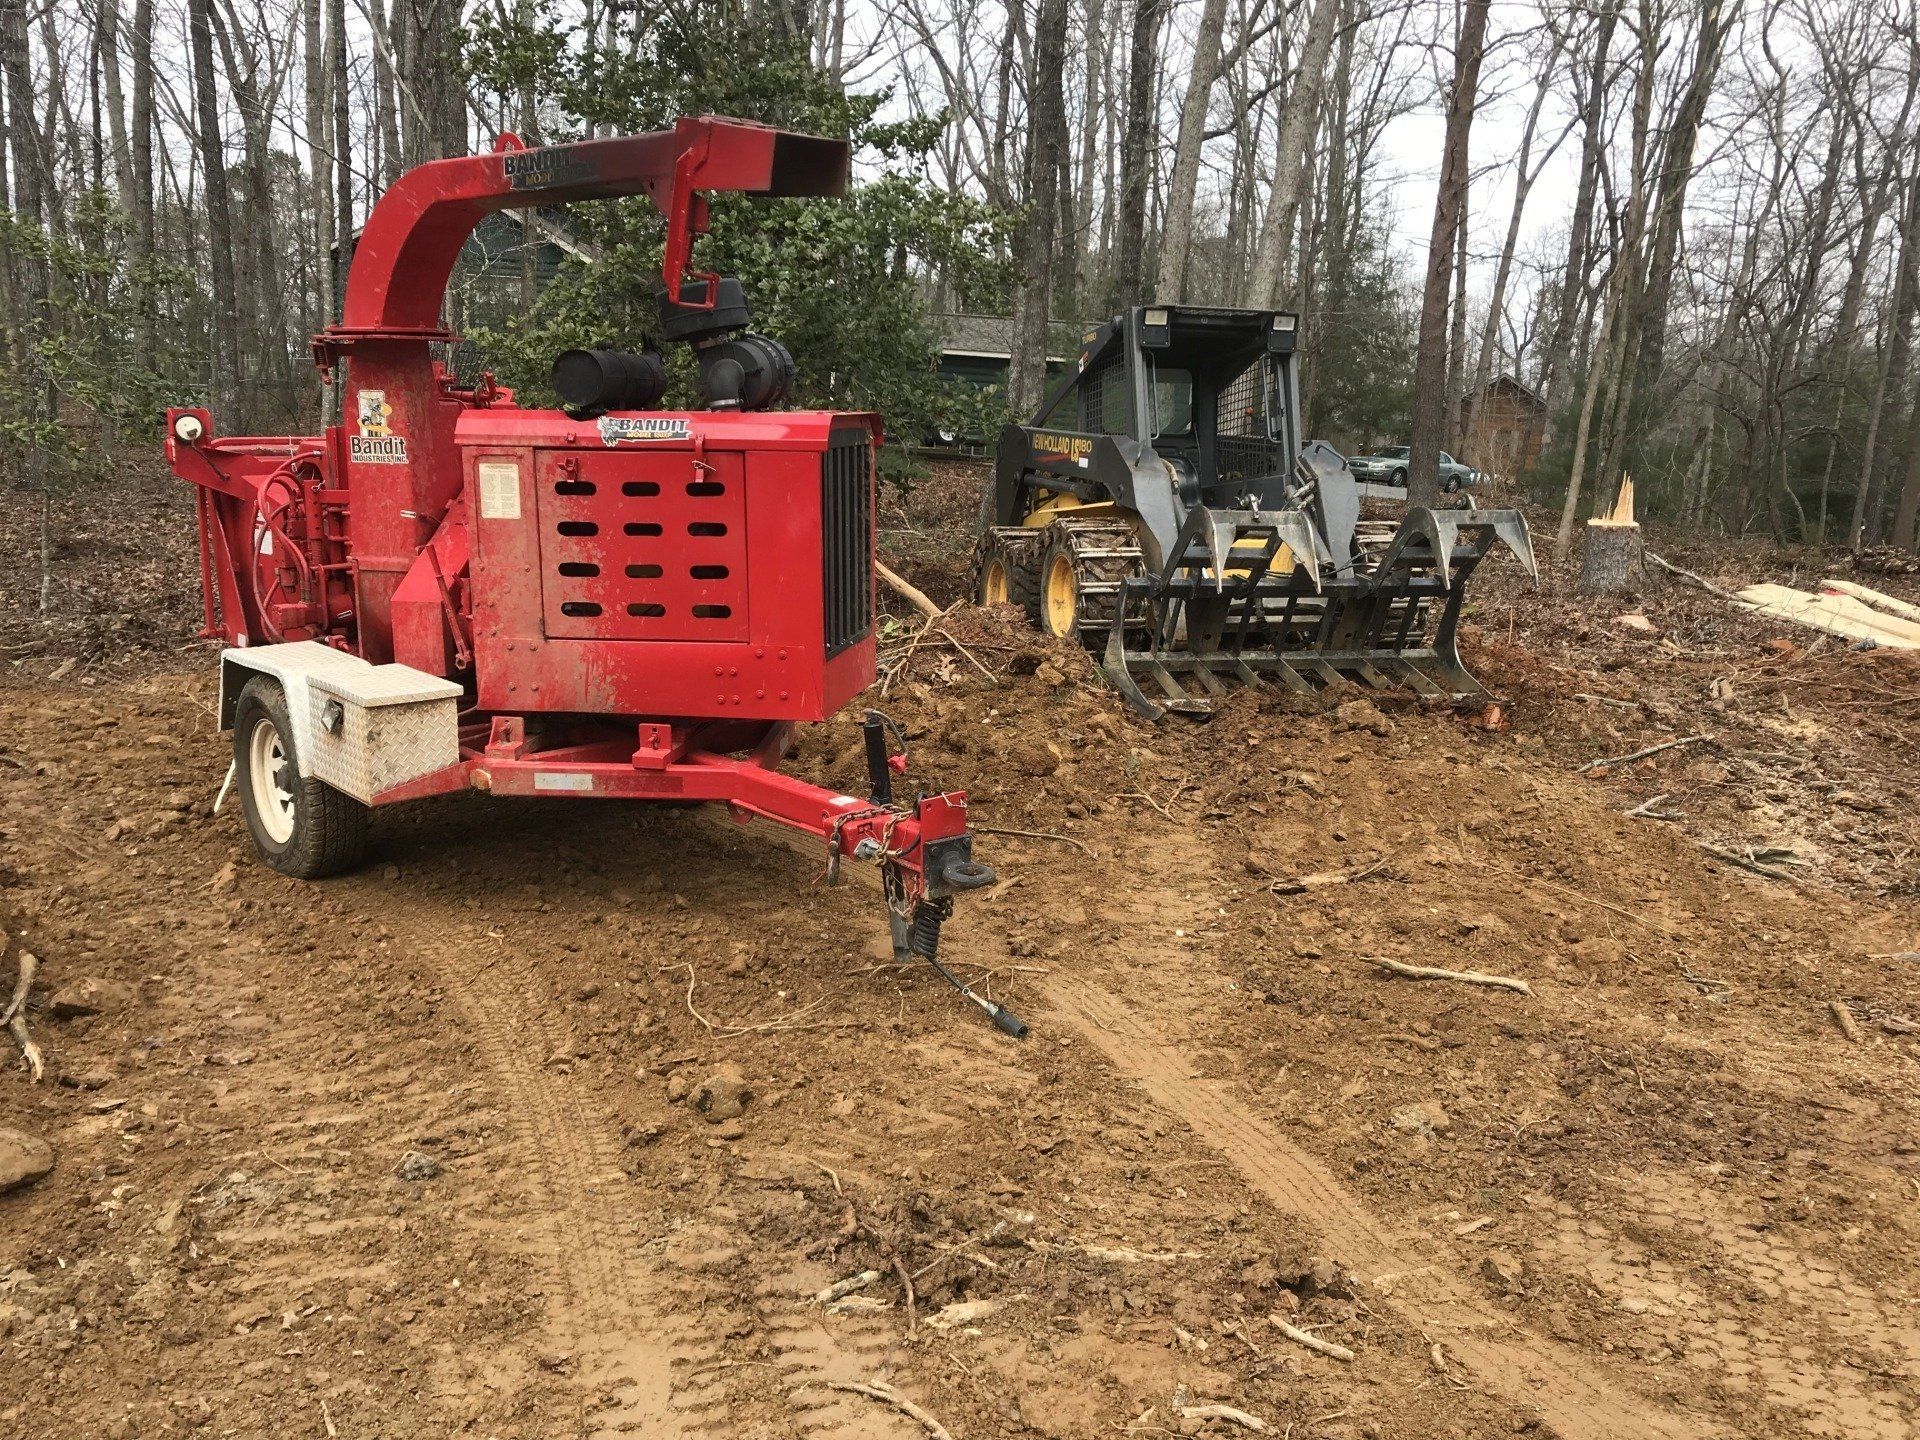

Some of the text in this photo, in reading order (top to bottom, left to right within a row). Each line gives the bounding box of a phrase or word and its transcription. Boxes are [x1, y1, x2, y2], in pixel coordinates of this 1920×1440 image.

[504, 149, 571, 176] BANDIT
[620, 420, 687, 431] BANDIT
[351, 437, 406, 454] Bandit
